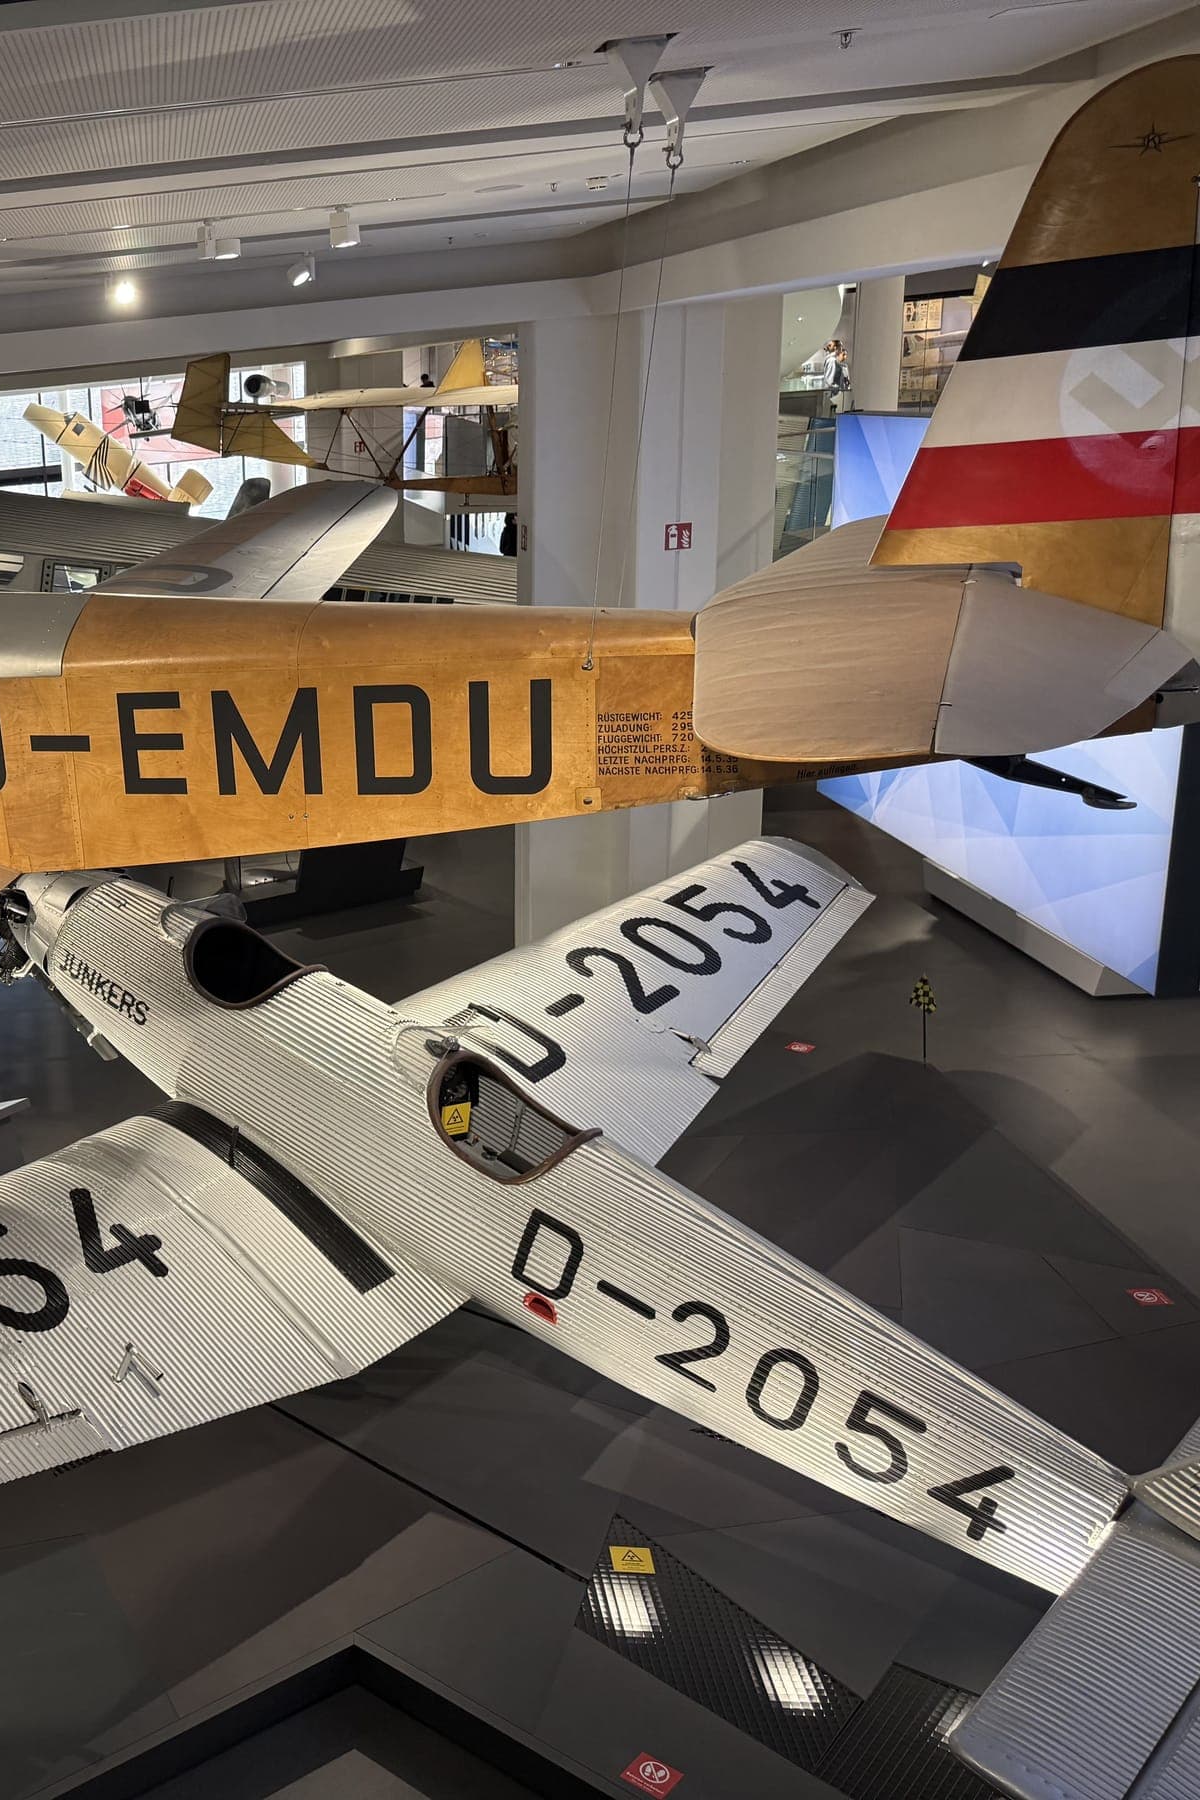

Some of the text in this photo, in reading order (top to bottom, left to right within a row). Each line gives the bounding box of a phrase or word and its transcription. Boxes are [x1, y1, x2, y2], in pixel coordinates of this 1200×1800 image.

[597, 711, 663, 722] RÜSTGEWICHT:
[597, 723, 653, 733] ZULADUNG:
[597, 733, 694, 744] FLUGGEWICHT: 720
[597, 755, 630, 765] LETZTE
[634, 754, 690, 764] NACHPRFG:
[645, 765, 699, 775] NACHPRFG:
[701, 765, 739, 774] 14.5.36
[443, 860, 822, 1083] D-2054
[60, 948, 150, 1026] JUNKERS
[511, 1207, 1015, 1541] D-2054
